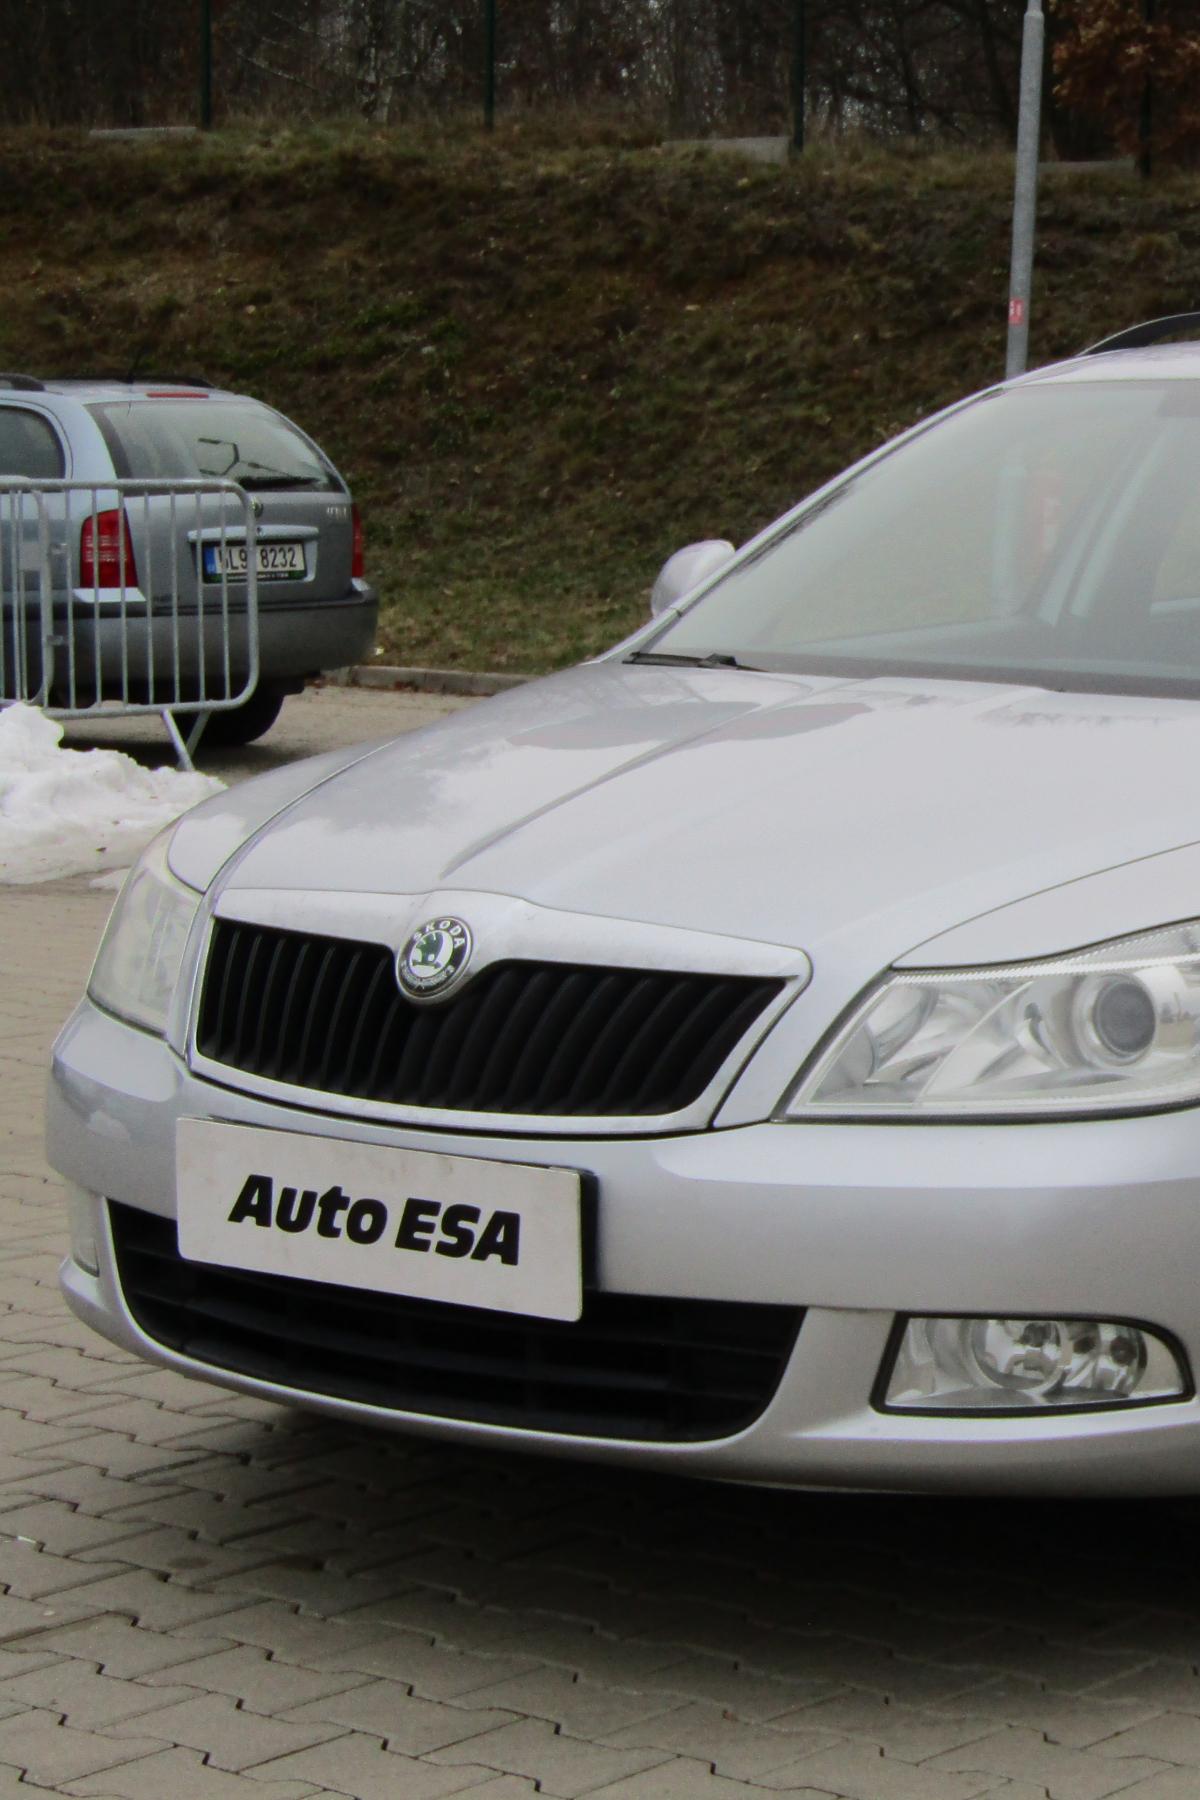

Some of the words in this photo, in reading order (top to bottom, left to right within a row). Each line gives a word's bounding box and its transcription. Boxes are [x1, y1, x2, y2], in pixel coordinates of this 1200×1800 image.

[260, 547, 297, 569] 8232
[228, 1174, 388, 1245] Auto
[394, 1198, 521, 1266] ESA
